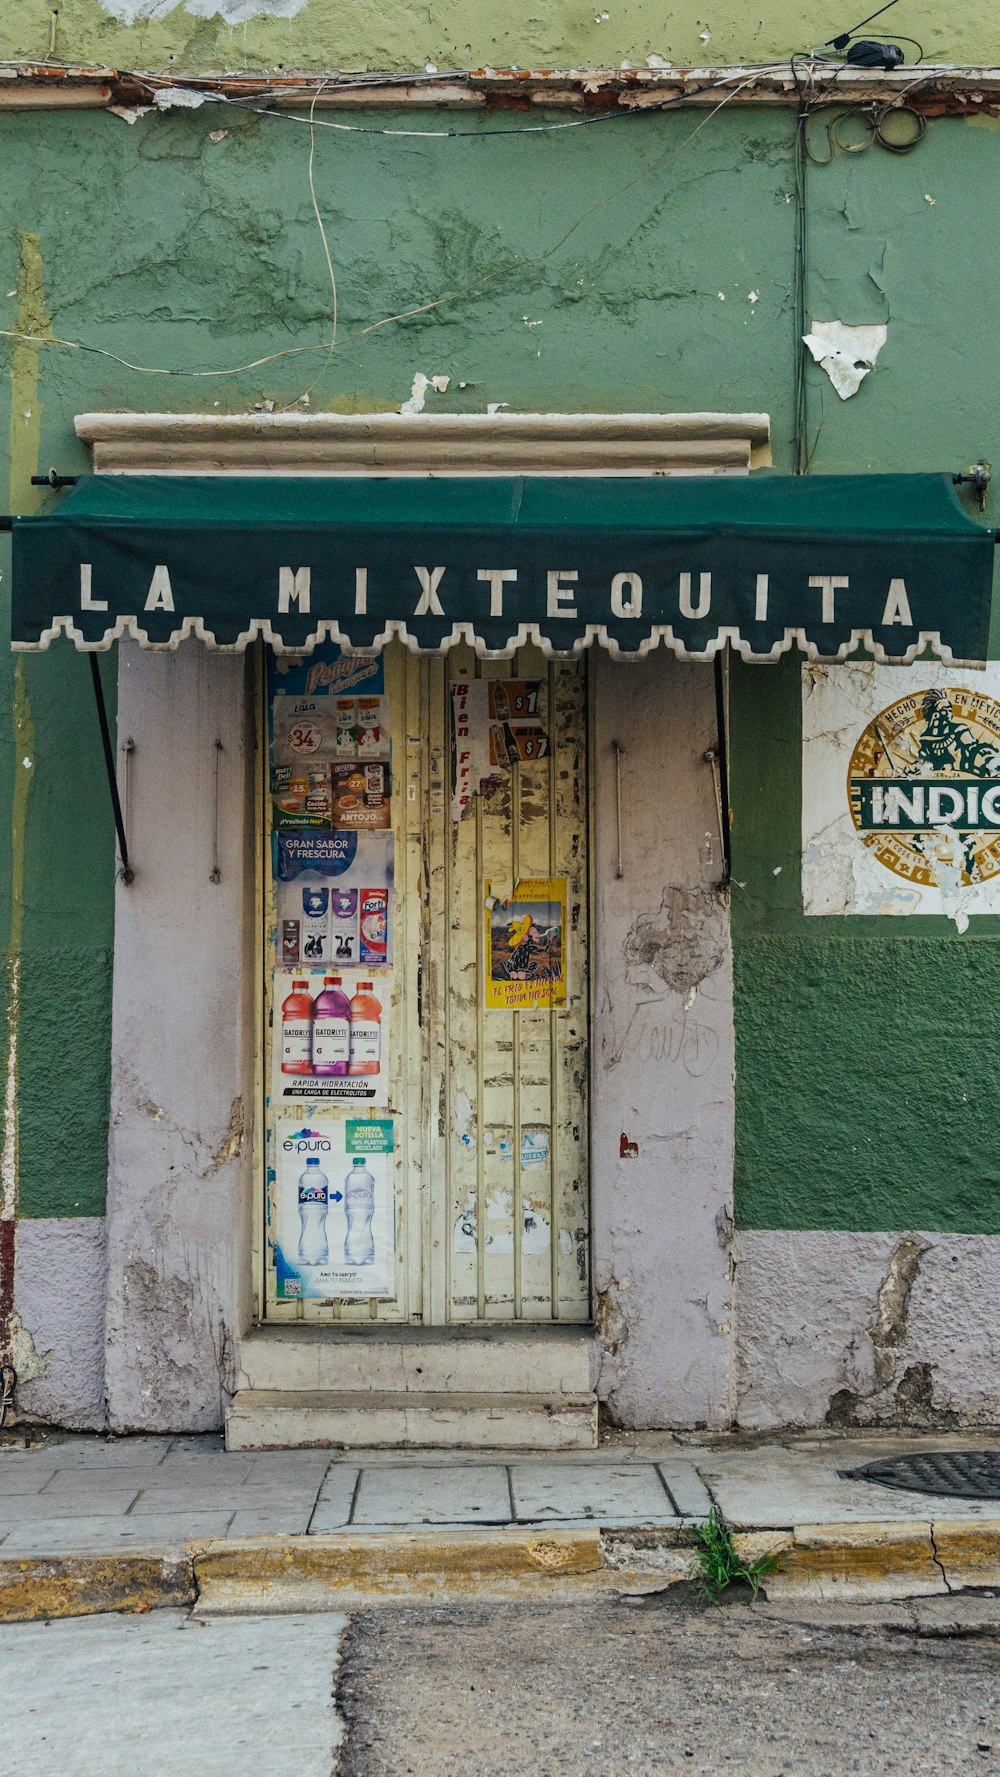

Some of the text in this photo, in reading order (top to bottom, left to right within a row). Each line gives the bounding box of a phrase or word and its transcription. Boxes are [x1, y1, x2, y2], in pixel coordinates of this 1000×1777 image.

[80, 563, 914, 627] LA MIXTEQUITA
[294, 703, 316, 712] LALA
[884, 699, 917, 723] HECHO
[955, 693, 967, 705] EN
[285, 839, 349, 849] GRAN SABOR
[288, 850, 346, 859] Y FRESCURA
[893, 844, 910, 859] COSA
[912, 855, 921, 864] ES
[315, 1028, 347, 1036] GATORLYTE
[321, 1079, 369, 1088] HIDRATACIÓN
[330, 1089, 368, 1097] ELECTROLITOS
